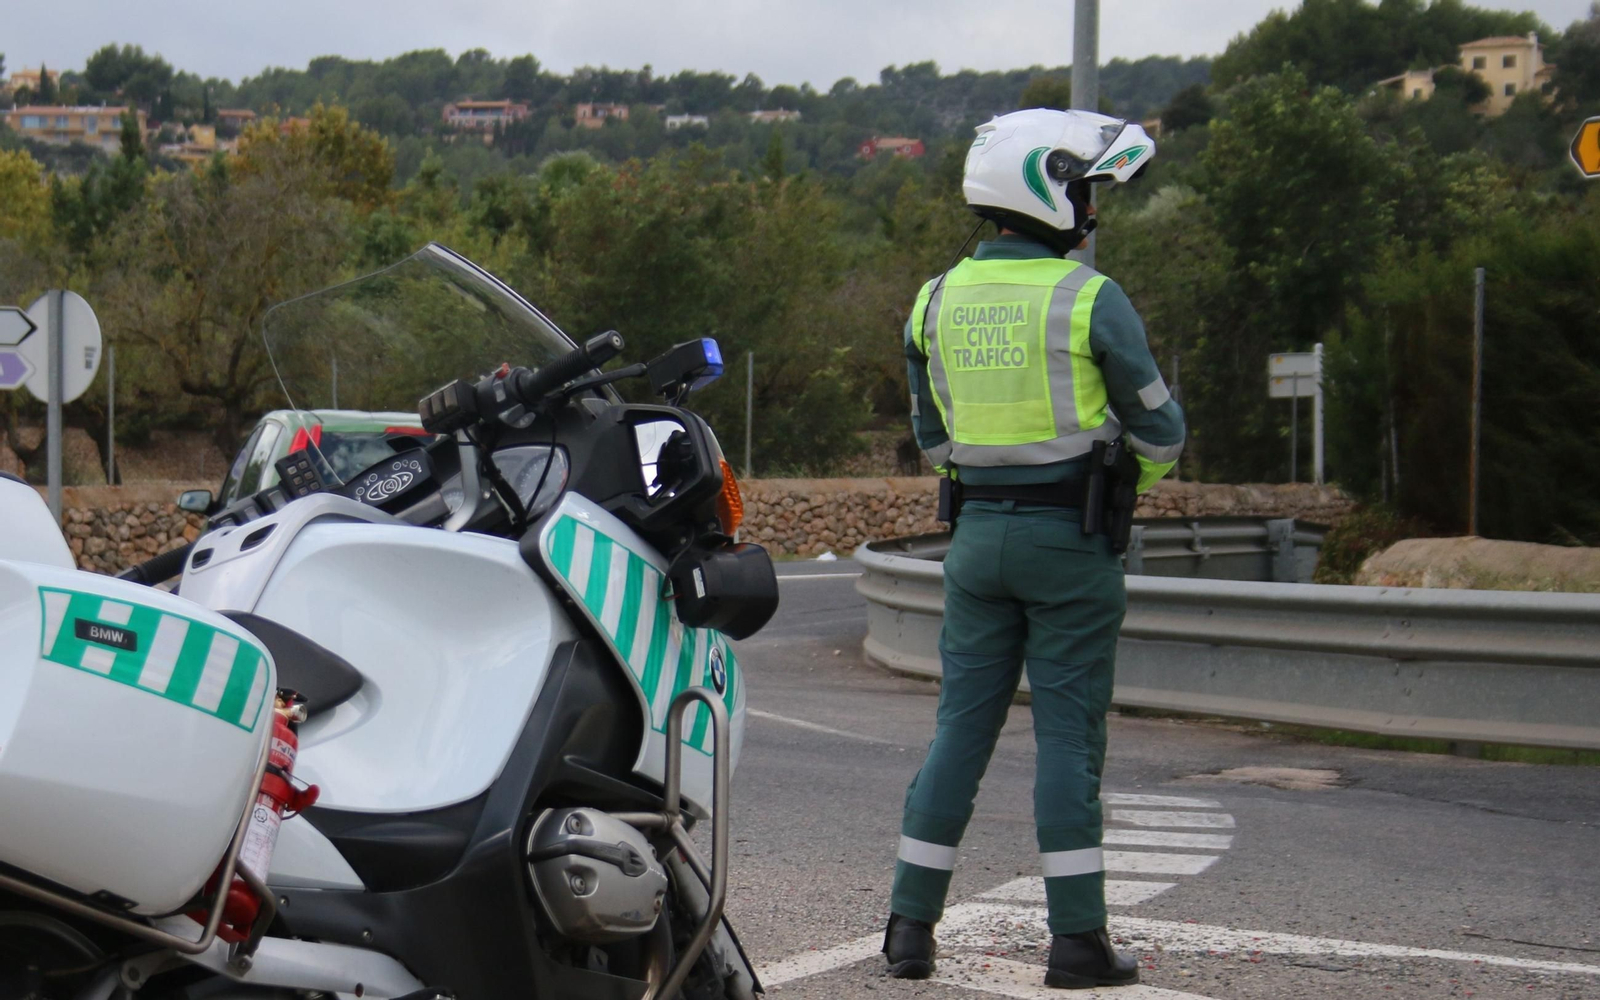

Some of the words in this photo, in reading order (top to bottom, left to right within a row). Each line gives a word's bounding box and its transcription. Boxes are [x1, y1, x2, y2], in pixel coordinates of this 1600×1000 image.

[952, 304, 1025, 326] GUARDIA
[966, 326, 1011, 347] CIVIL
[953, 346, 1025, 368] TRAFICO
[90, 625, 124, 643] BMW
